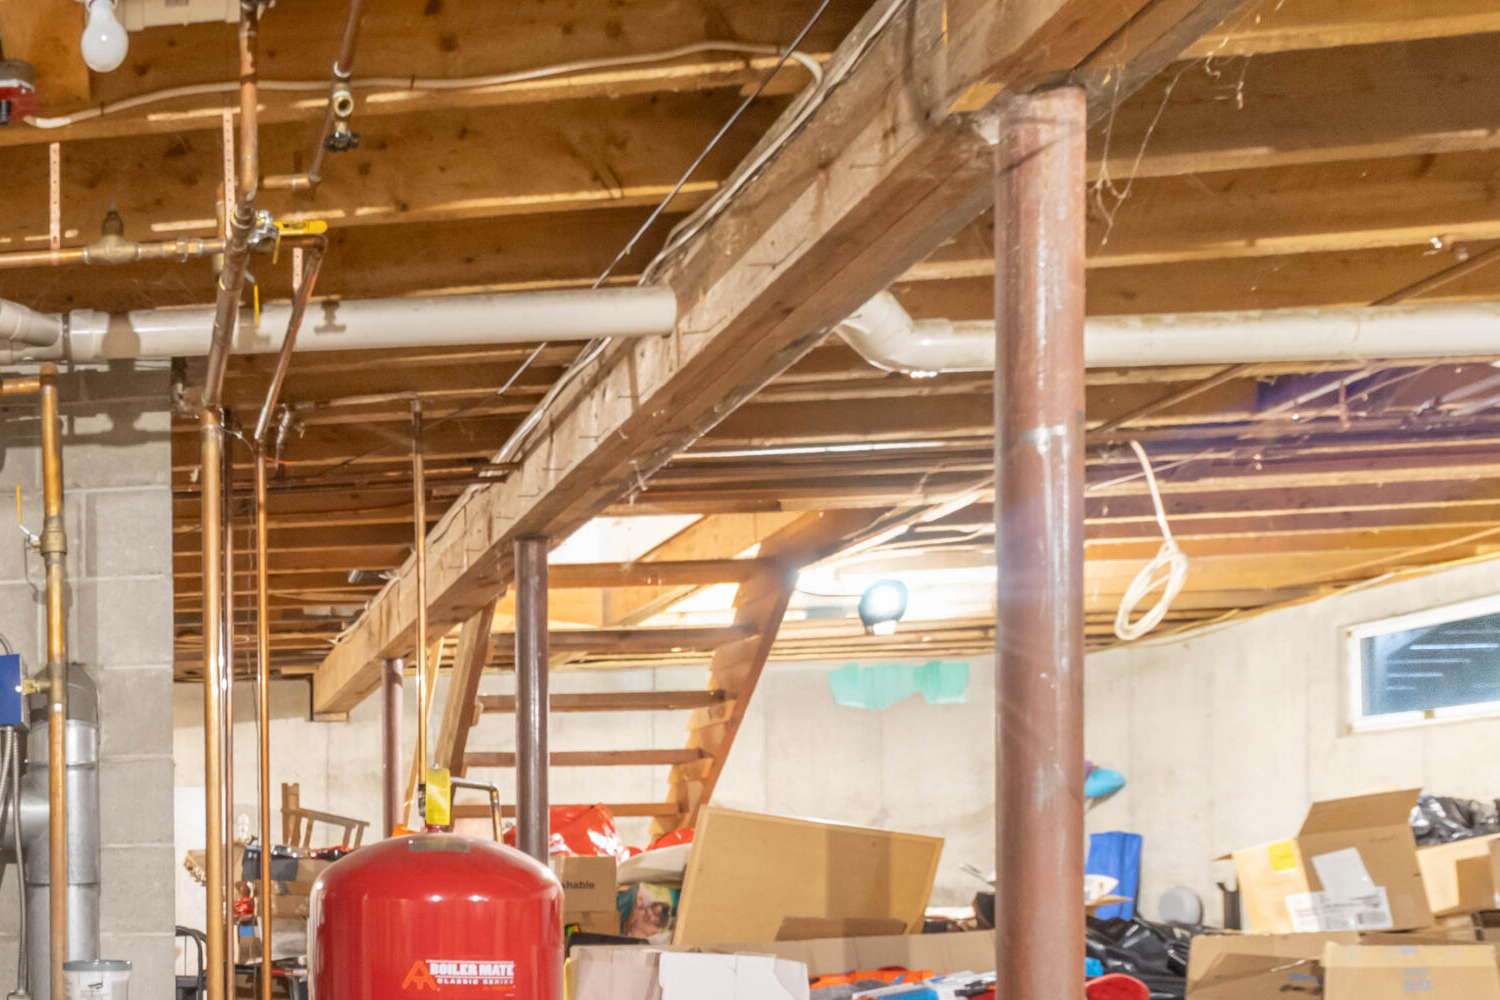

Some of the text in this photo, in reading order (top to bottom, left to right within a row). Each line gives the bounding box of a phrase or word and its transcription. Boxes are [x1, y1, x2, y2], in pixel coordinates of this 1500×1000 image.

[561, 880, 596, 889] shable
[430, 963, 514, 976] BOILER MATE
